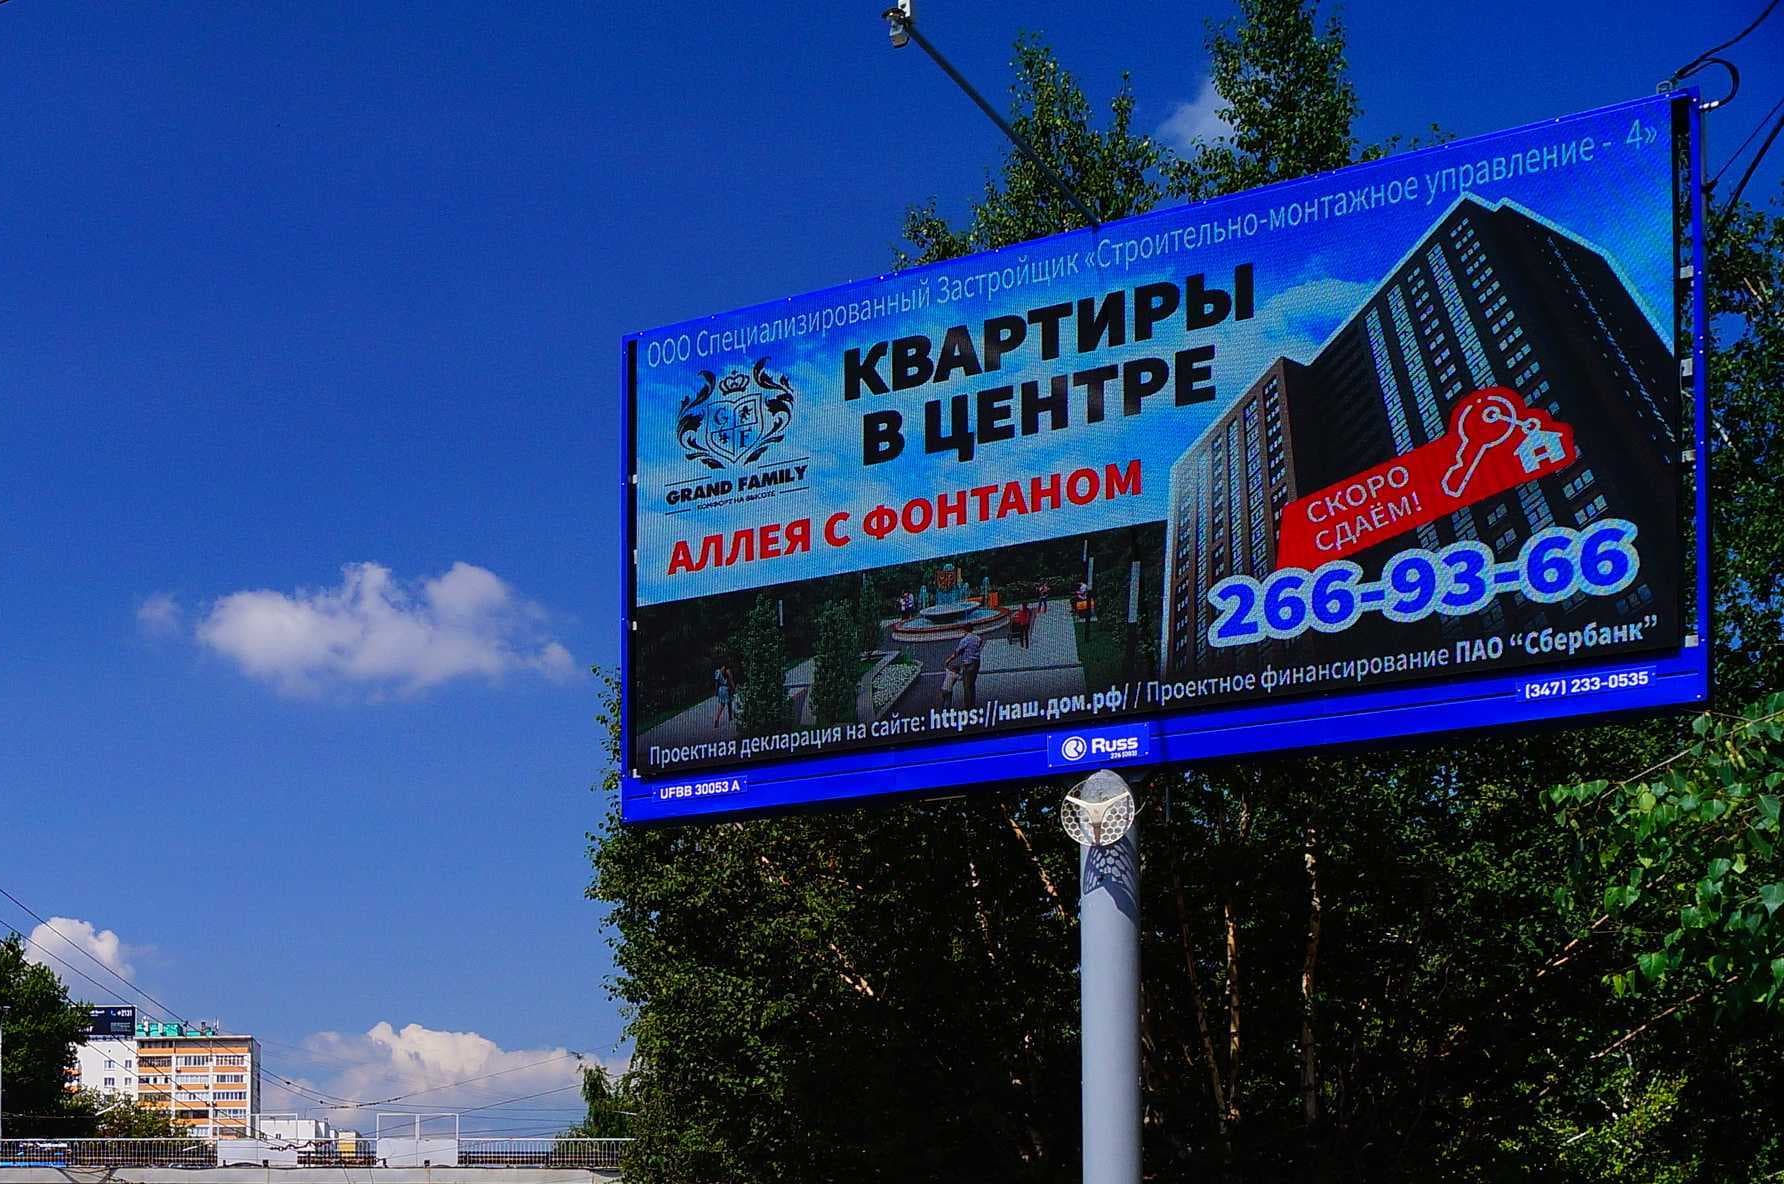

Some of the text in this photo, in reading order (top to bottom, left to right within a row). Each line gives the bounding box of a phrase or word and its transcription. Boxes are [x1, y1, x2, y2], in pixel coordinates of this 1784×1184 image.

[648, 334, 691, 367] ООО
[697, 278, 930, 357] Специализированный
[936, 256, 1080, 304] Застройщик
[1085, 175, 1417, 271] «Строительно-монтажное
[1427, 137, 1594, 206] управление
[1626, 118, 1657, 150] 4»
[844, 263, 1254, 400] КВАРТИРЫ
[863, 345, 1216, 465] В ЦЕНТРЕ
[666, 465, 808, 505] GRAND FAMILY
[667, 459, 1142, 575] АЛЛЕЯ С ФОНТАНОМ
[1307, 465, 1410, 525] СКОРО
[1315, 492, 1422, 551] СДАЁМ!
[1212, 523, 1634, 642] 266-93-66
[649, 738, 737, 767] Проектная
[740, 726, 841, 758] декларация
[846, 722, 866, 741] на
[871, 712, 925, 738] сайте:
[1147, 671, 1255, 706] Проектное
[1260, 646, 1450, 698] финансирование
[1455, 635, 1503, 665] ПАО
[1525, 672, 1648, 699] (347) 233-0535
[1091, 737, 1138, 754] Russ
[660, 781, 740, 799] UFBB 30053 A
